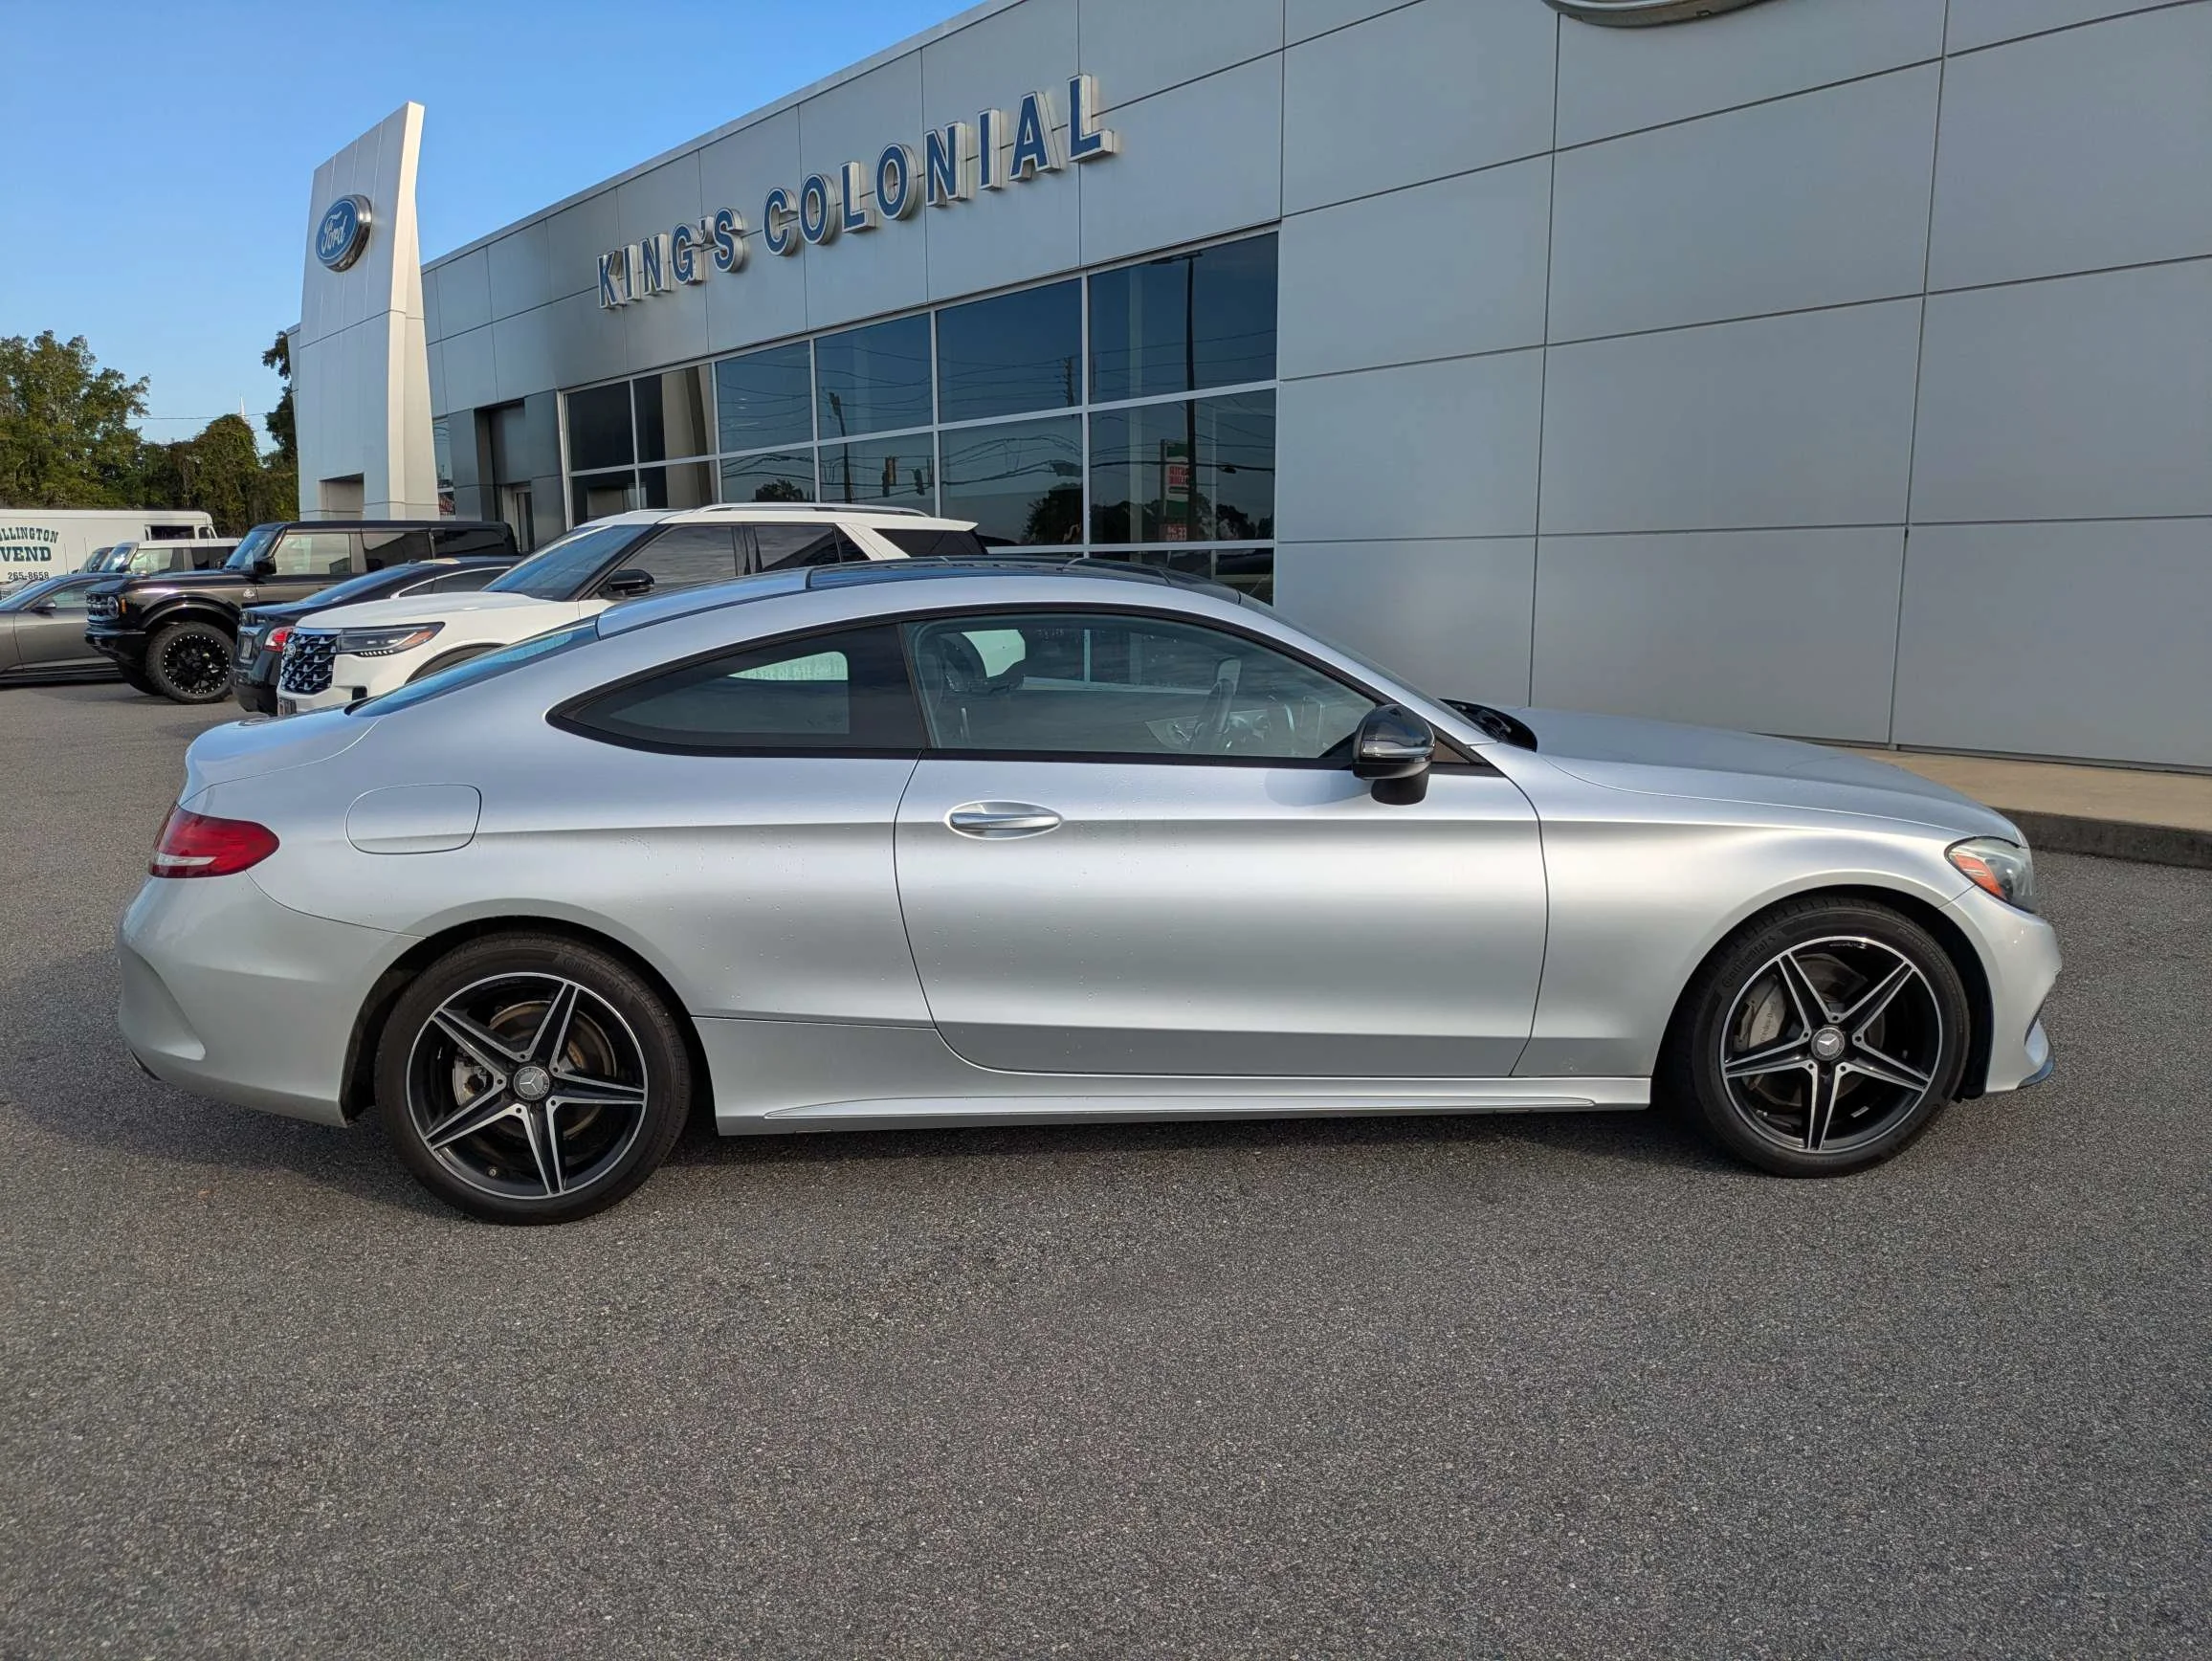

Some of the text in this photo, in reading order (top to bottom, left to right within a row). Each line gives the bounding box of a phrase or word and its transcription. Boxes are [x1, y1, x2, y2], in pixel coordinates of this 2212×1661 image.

[596, 74, 1115, 309] KING'S COLONIAL
[320, 210, 349, 255] Ford
[0, 526, 59, 543] LLINGTON
[0, 545, 53, 563] VEND
